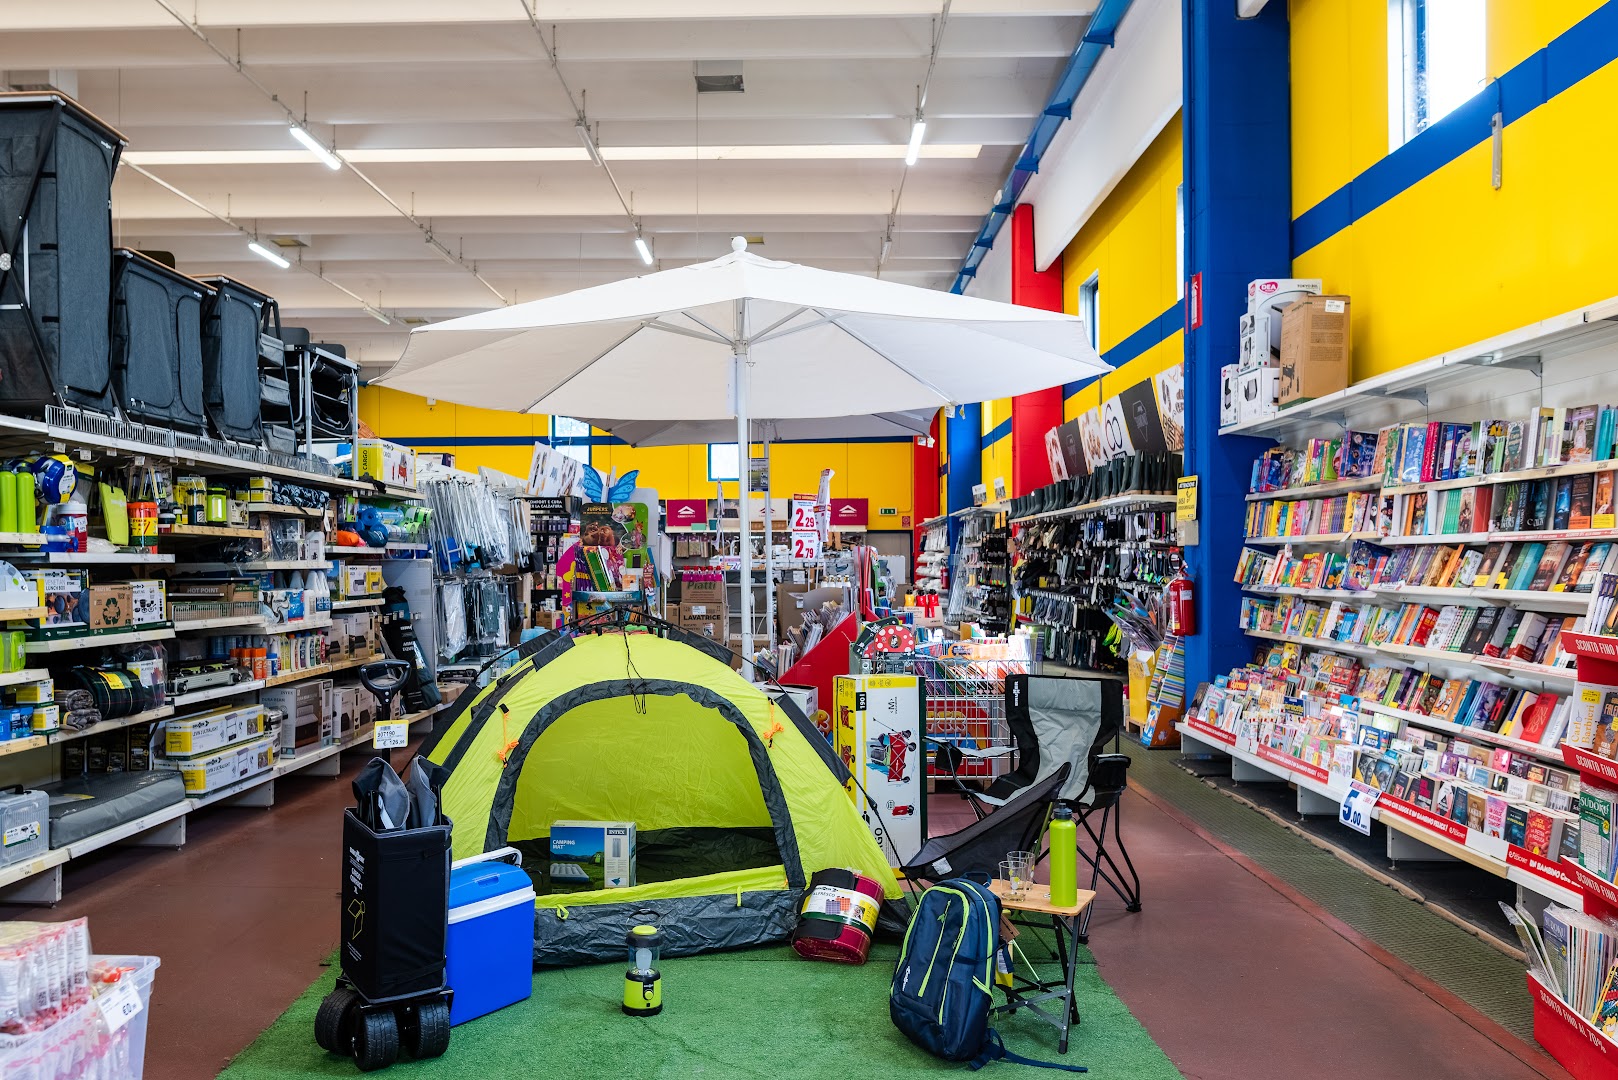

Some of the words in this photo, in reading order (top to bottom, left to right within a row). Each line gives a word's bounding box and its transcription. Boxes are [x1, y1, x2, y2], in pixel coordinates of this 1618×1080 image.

[795, 508, 804, 527] 2
[805, 518, 815, 528] 29
[795, 539, 804, 559] 2
[805, 548, 814, 559] 79
[1575, 639, 1598, 653] SCONTO
[1598, 641, 1615, 656] FINO
[1582, 704, 1595, 744] Barbieri
[1575, 754, 1600, 773] SCONTO
[1600, 763, 1617, 778] FINO
[1580, 795, 1610, 816] SUDOKU
[1575, 870, 1600, 893] SCONTO
[1600, 884, 1618, 903] FINO
[1539, 989, 1563, 1016] SCONTO
[1562, 1010, 1578, 1030] FINO
[1578, 1022, 1587, 1037] AL
